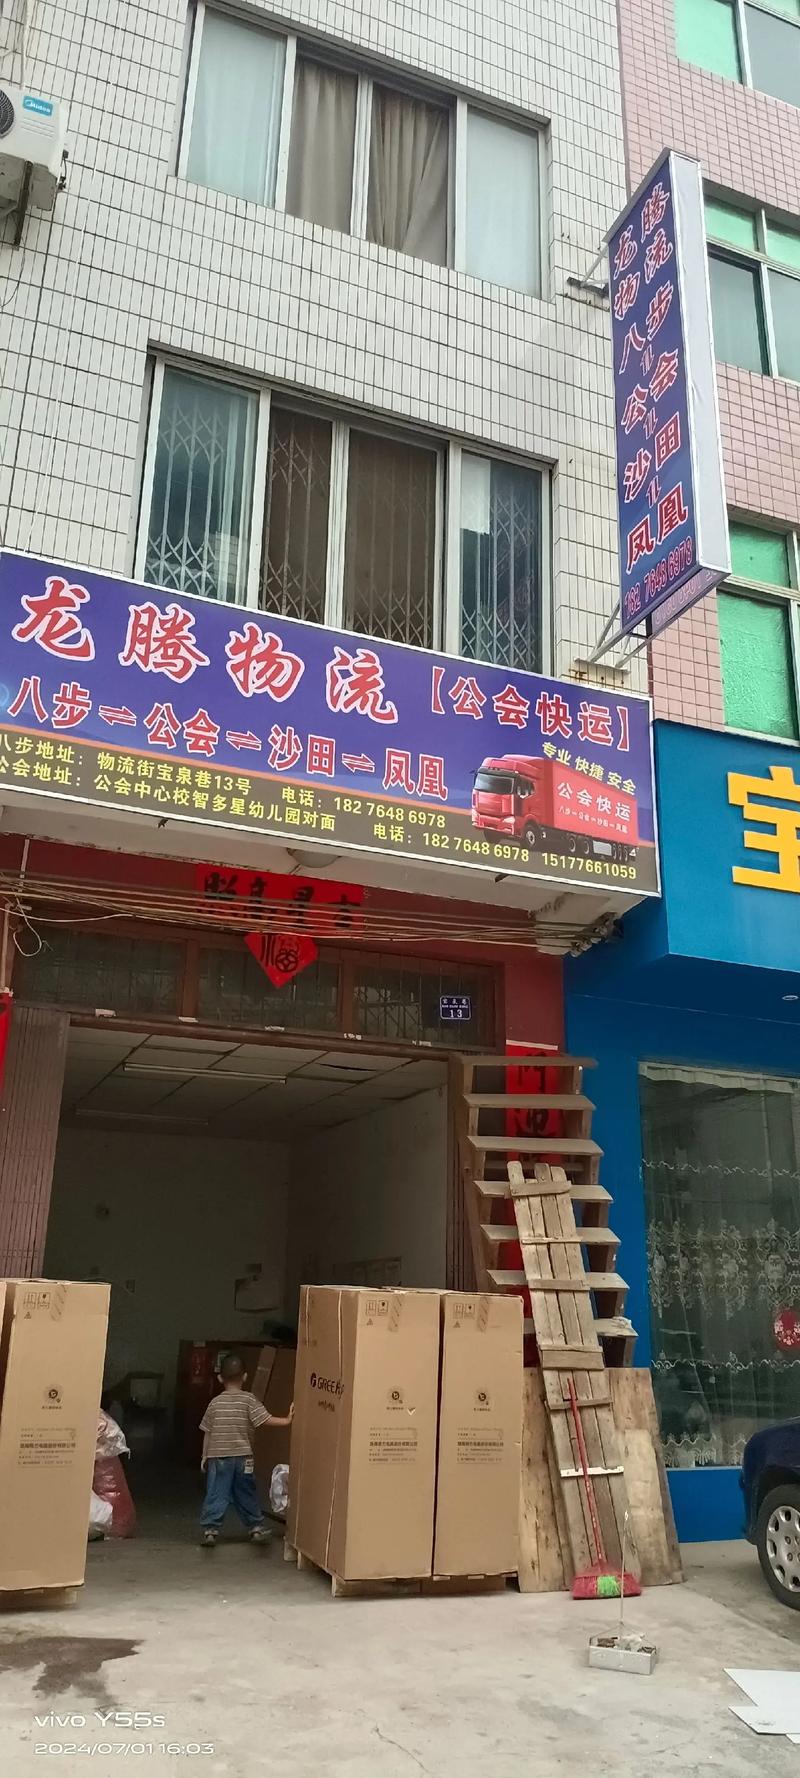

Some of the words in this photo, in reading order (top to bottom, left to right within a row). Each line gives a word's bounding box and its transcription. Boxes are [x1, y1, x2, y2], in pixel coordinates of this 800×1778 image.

[624, 582, 641, 619] 182
[644, 558, 667, 602] 7648
[667, 535, 692, 581] 6978
[12, 576, 399, 725] 龙腾物流
[8, 676, 92, 728] 八步
[144, 703, 220, 756] 公会
[267, 723, 337, 776] 沙田
[382, 748, 448, 801] 凤凰
[542, 742, 571, 766] 专业
[575, 756, 604, 781] 快捷
[607, 771, 636, 795] 安全
[334, 797, 362, 814] 182
[366, 803, 404, 821] 7648
[408, 810, 445, 828] 6978
[557, 782, 631, 821] 公会快运
[423, 832, 449, 849] 182
[453, 837, 490, 855] 7648
[494, 844, 529, 862] 6978
[541, 852, 637, 879] 15177661059
[728, 766, 800, 893] 宝
[450, 1009, 463, 1018] 13
